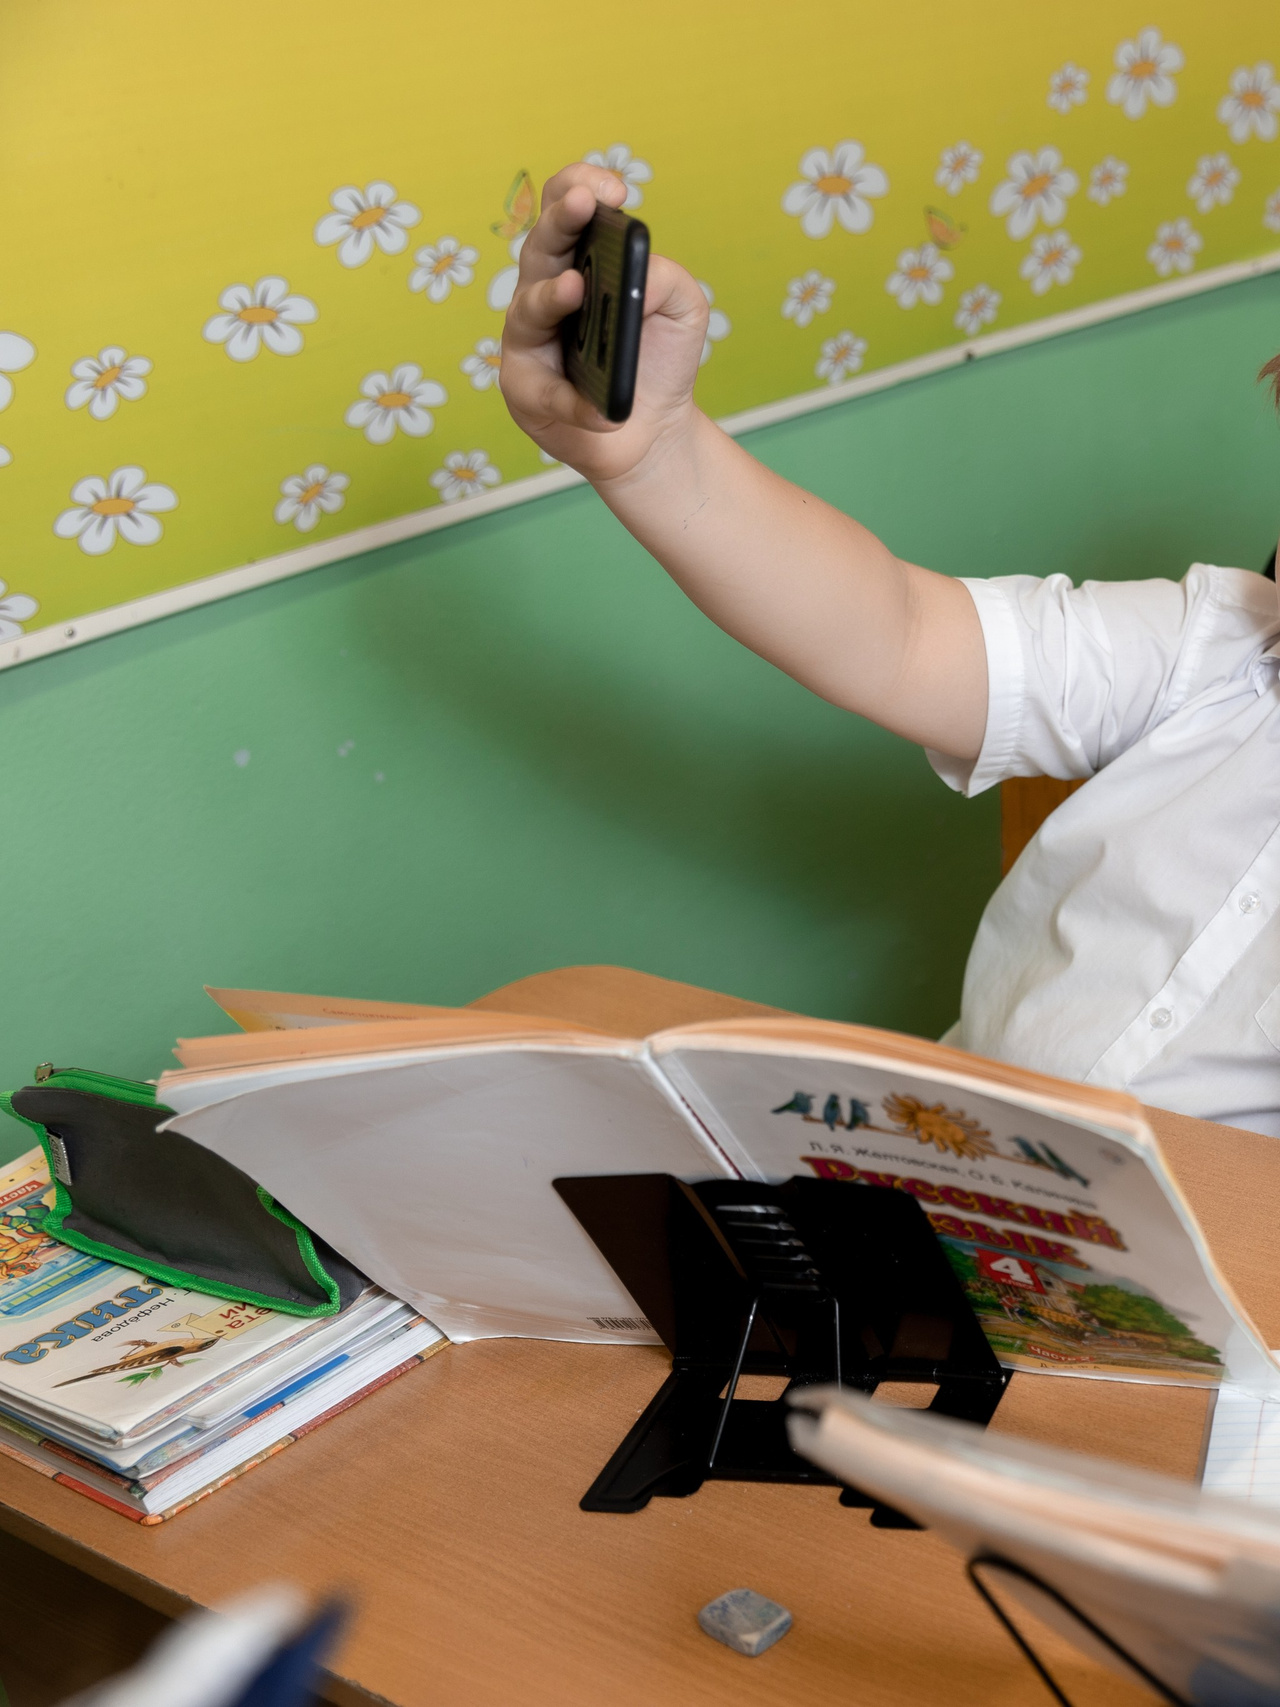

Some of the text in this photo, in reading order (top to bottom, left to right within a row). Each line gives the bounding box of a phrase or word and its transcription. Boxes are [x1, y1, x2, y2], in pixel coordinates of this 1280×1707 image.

[927, 1211, 1094, 1272] зык
[990, 1256, 1035, 1286] 4
[91, 1296, 176, 1344] Нефёдова
